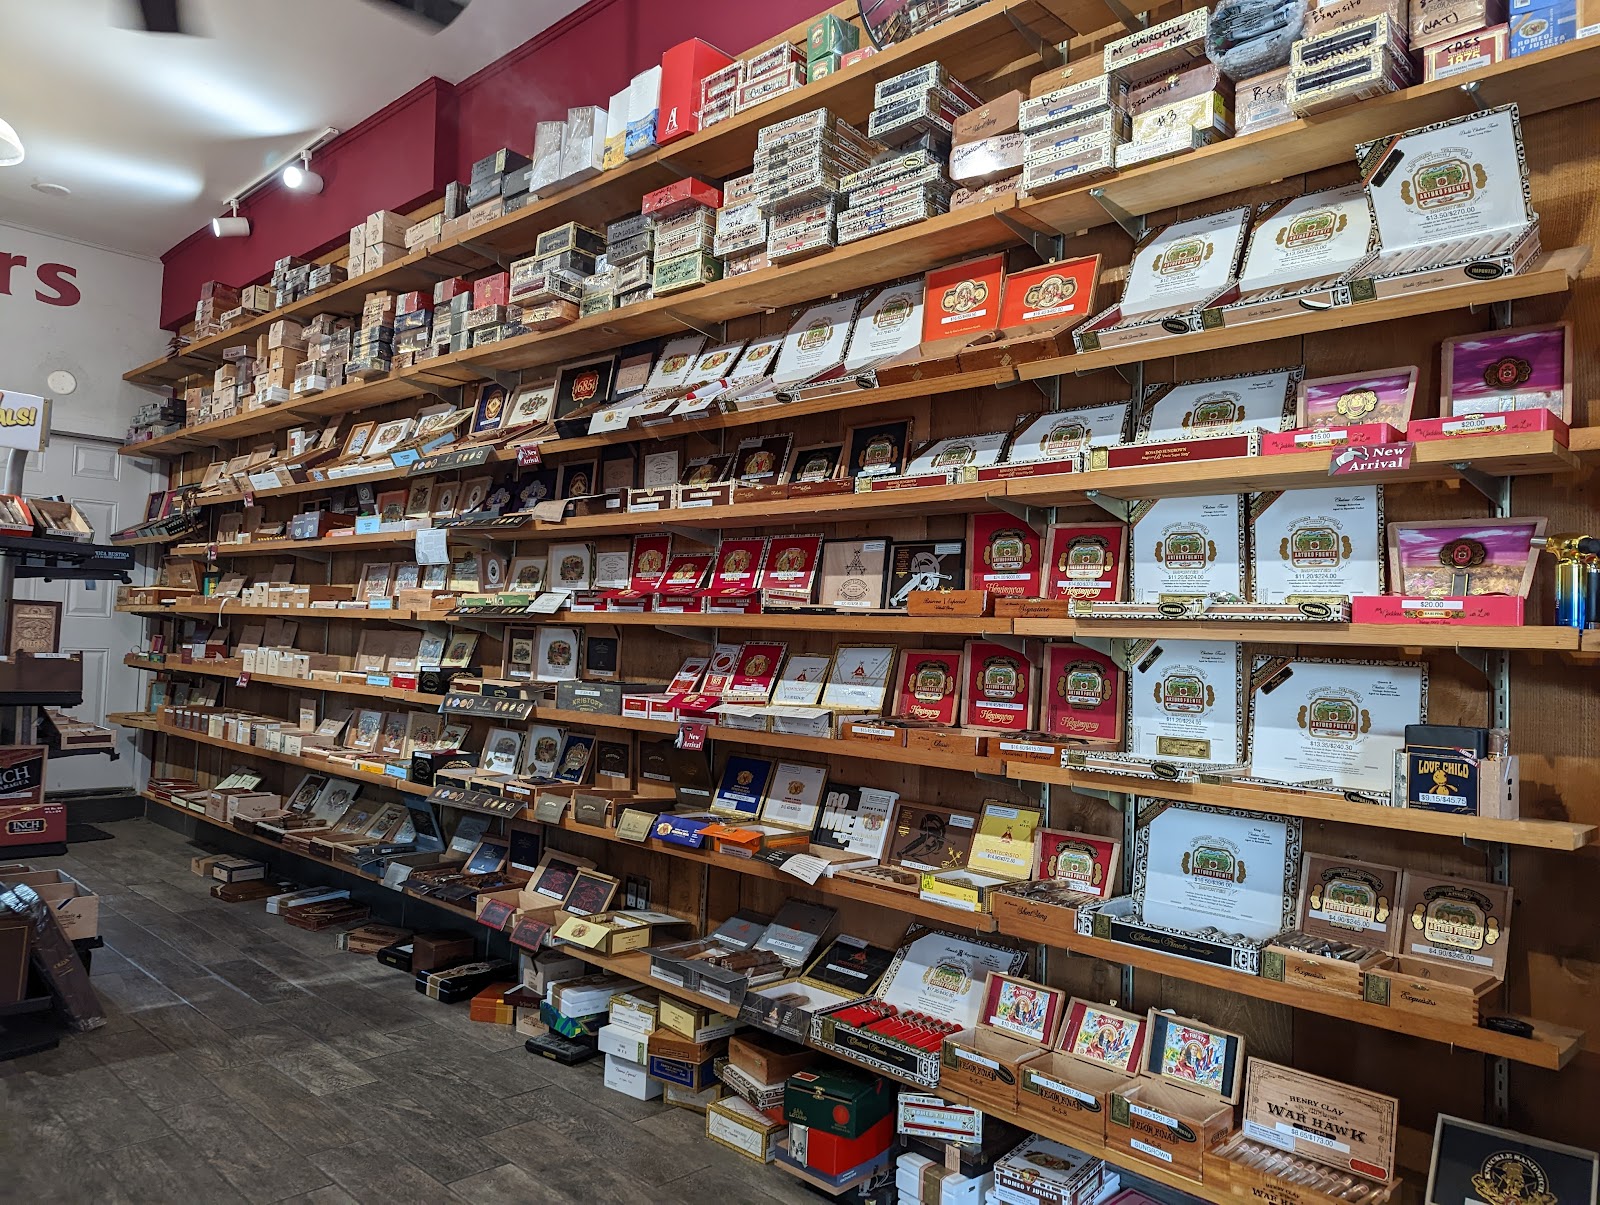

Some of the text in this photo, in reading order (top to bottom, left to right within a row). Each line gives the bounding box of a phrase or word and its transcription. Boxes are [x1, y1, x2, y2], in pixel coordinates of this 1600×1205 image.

[1132, 25, 1185, 48] CHURCHILL
[1169, 30, 1191, 46] NAT
[1518, 34, 1550, 47] ROMEO
[1528, 35, 1566, 50] JULIETA
[1442, 36, 1481, 54] TRES
[1448, 51, 1481, 65] 1875
[1132, 62, 1192, 91] AF HEMINGWAY
[1418, 182, 1470, 200] ARTURO FUENTE
[1426, 206, 1476, 220] $13.50/$270.00
[1462, 420, 1486, 428] $20.00
[1372, 448, 1406, 458] New
[1348, 457, 1402, 472] Arrival
[986, 583, 1025, 595] Hemingway
[1061, 587, 1101, 599] Hemingway
[1166, 696, 1201, 705] ARTURO FUENTE
[980, 710, 1014, 724] Hemingway
[1060, 716, 1100, 732] Hemingway
[1333, 722, 1355, 730] FUENTE
[688, 732, 700, 740] New
[683, 740, 702, 749] Arrival
[1310, 740, 1353, 750] $13.35/$240.30
[1418, 760, 1470, 779] LOVE CHILD
[1421, 794, 1467, 804] $9.15/$45.75
[12, 820, 40, 830] INCH
[1194, 868, 1232, 880] ARTURO FUENTE
[1325, 902, 1372, 918] ARTURO FUENTE
[1328, 914, 1370, 928] $4.90/$245.00
[1428, 921, 1480, 939] ARTURO FUENTE
[1130, 932, 1188, 950] Chateau Fuente
[1428, 948, 1474, 962] $4.90/$245.00
[1001, 1020, 1033, 1036] $10.70/$267.50
[966, 1052, 988, 1066] NATURAL
[1045, 1080, 1082, 1098] $10.70/$267.50
[1052, 1106, 1068, 1117] 8-5-8
[1290, 1095, 1345, 1116] HENRY CLAY
[1133, 1106, 1174, 1126] $11.65/$291.25
[1266, 1102, 1307, 1124] WAR
[1311, 1117, 1368, 1144] HAWK
[1290, 1129, 1334, 1148] $8.65/$173.00
[1134, 1141, 1170, 1160] SUNGROWN
[1484, 1153, 1544, 1193] KNUCKLE SANDWICH
[1002, 1178, 1025, 1190] ROMEO
[1032, 1186, 1058, 1201] JULIETA
[1251, 1187, 1278, 1202] WAR
[1265, 1182, 1300, 1199] HENRY CLAY
